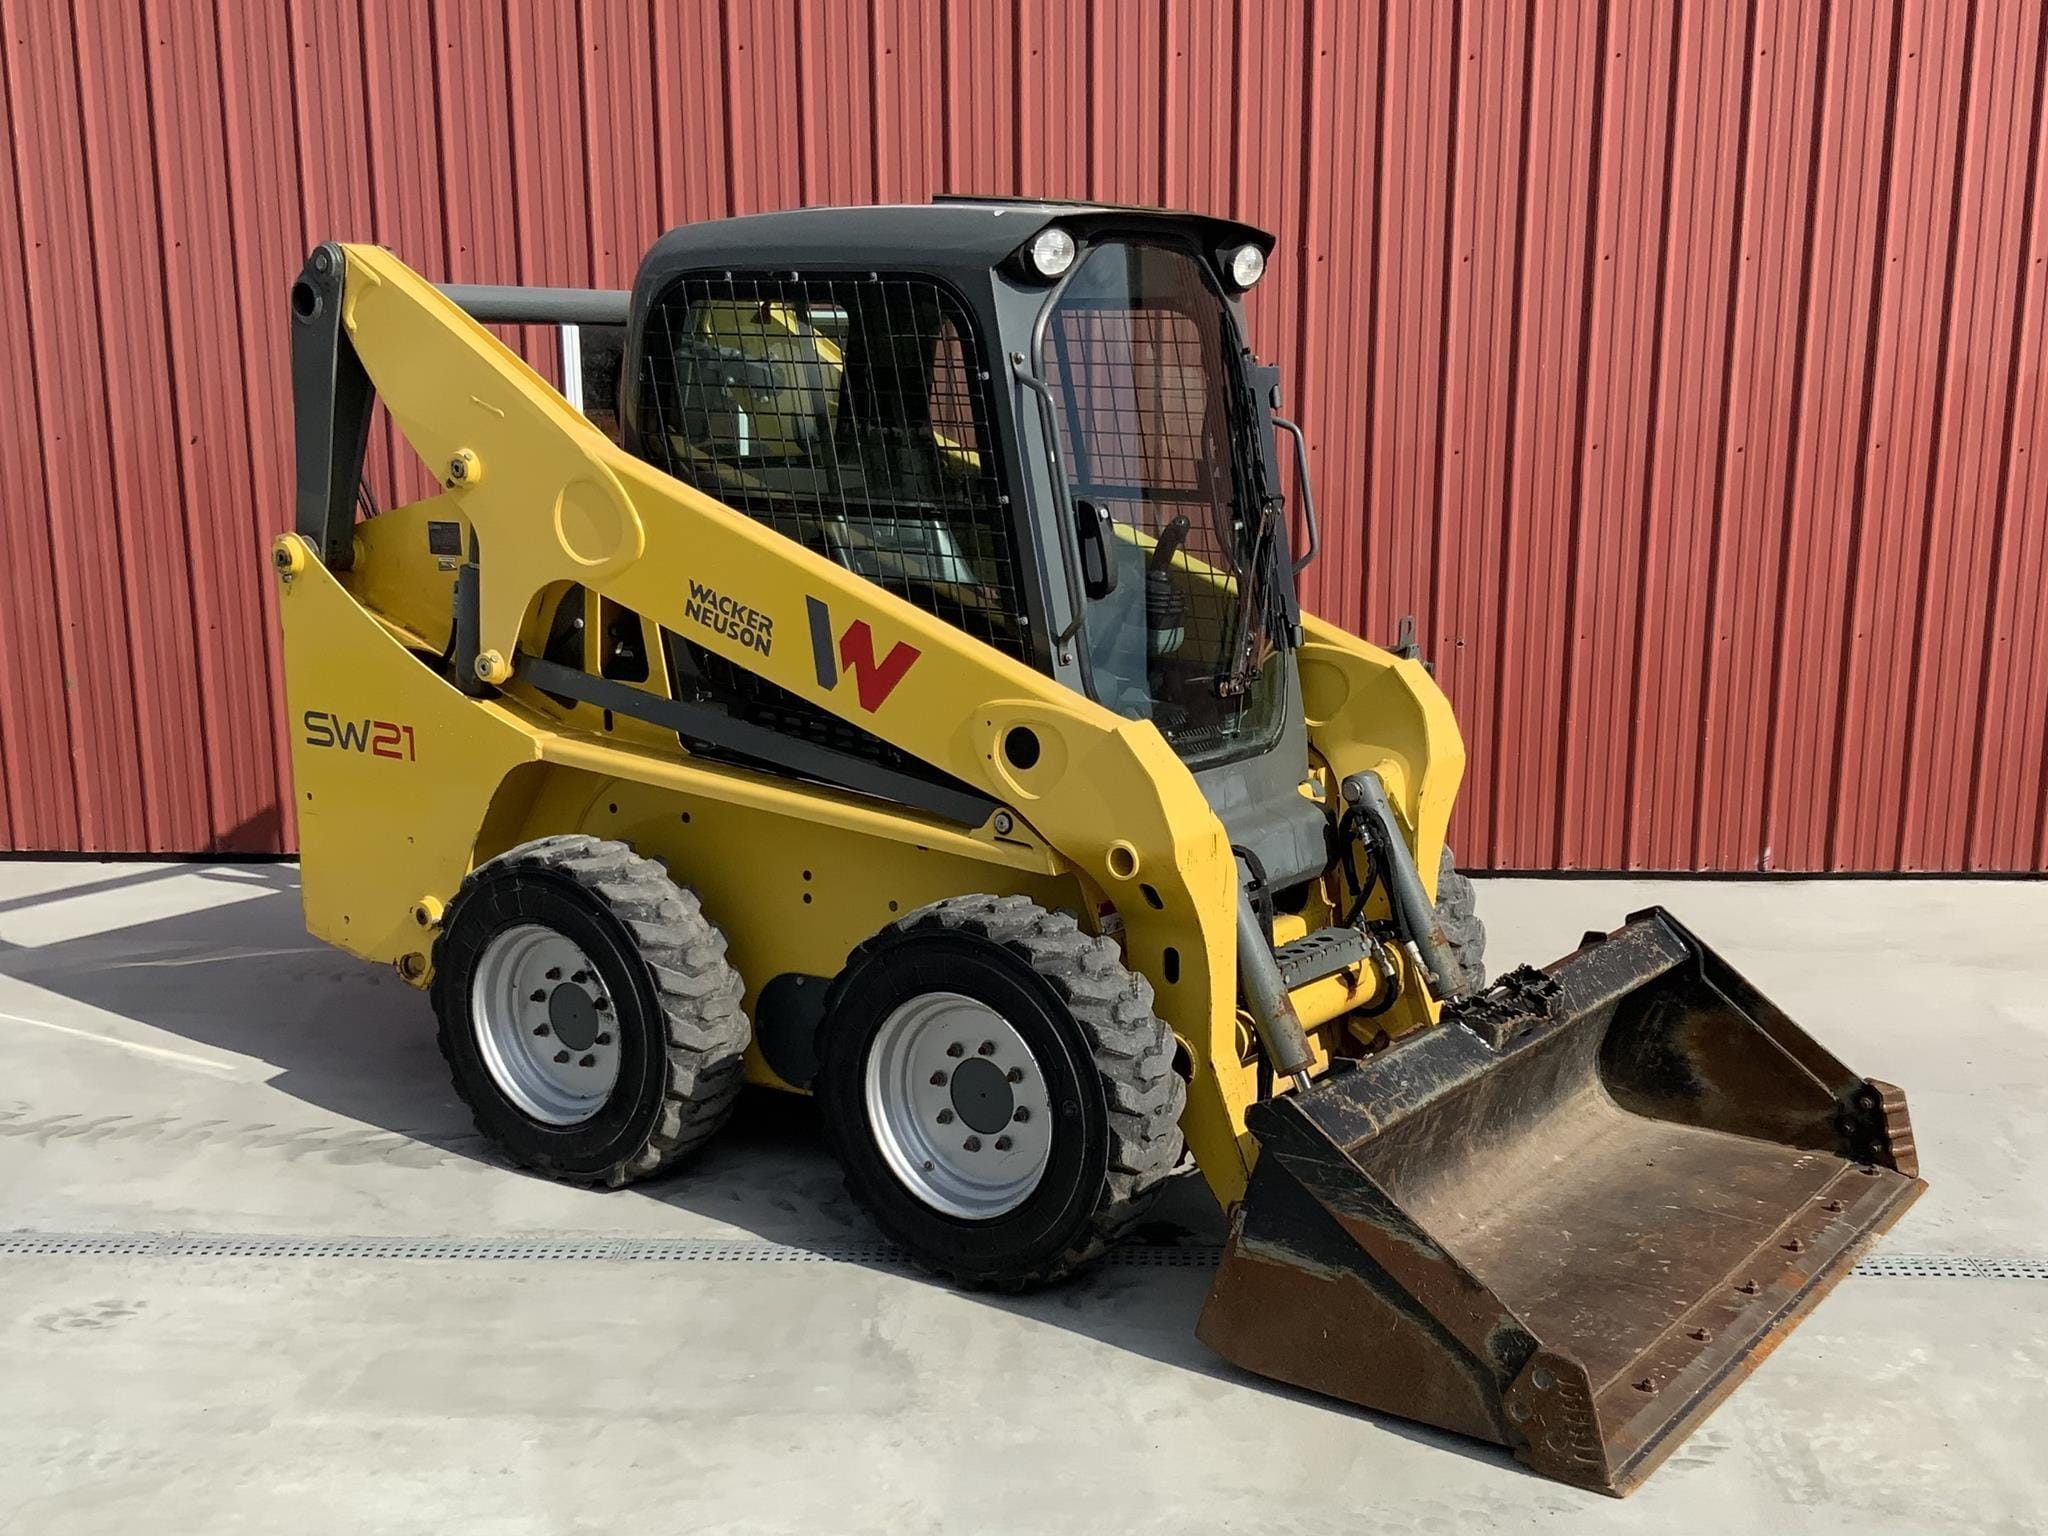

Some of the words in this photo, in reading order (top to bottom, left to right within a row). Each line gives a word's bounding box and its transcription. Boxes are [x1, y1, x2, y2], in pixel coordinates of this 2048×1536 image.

[685, 599, 772, 657] NEUSON
[689, 579, 774, 637] WACKER
[304, 710, 416, 762] SW21
